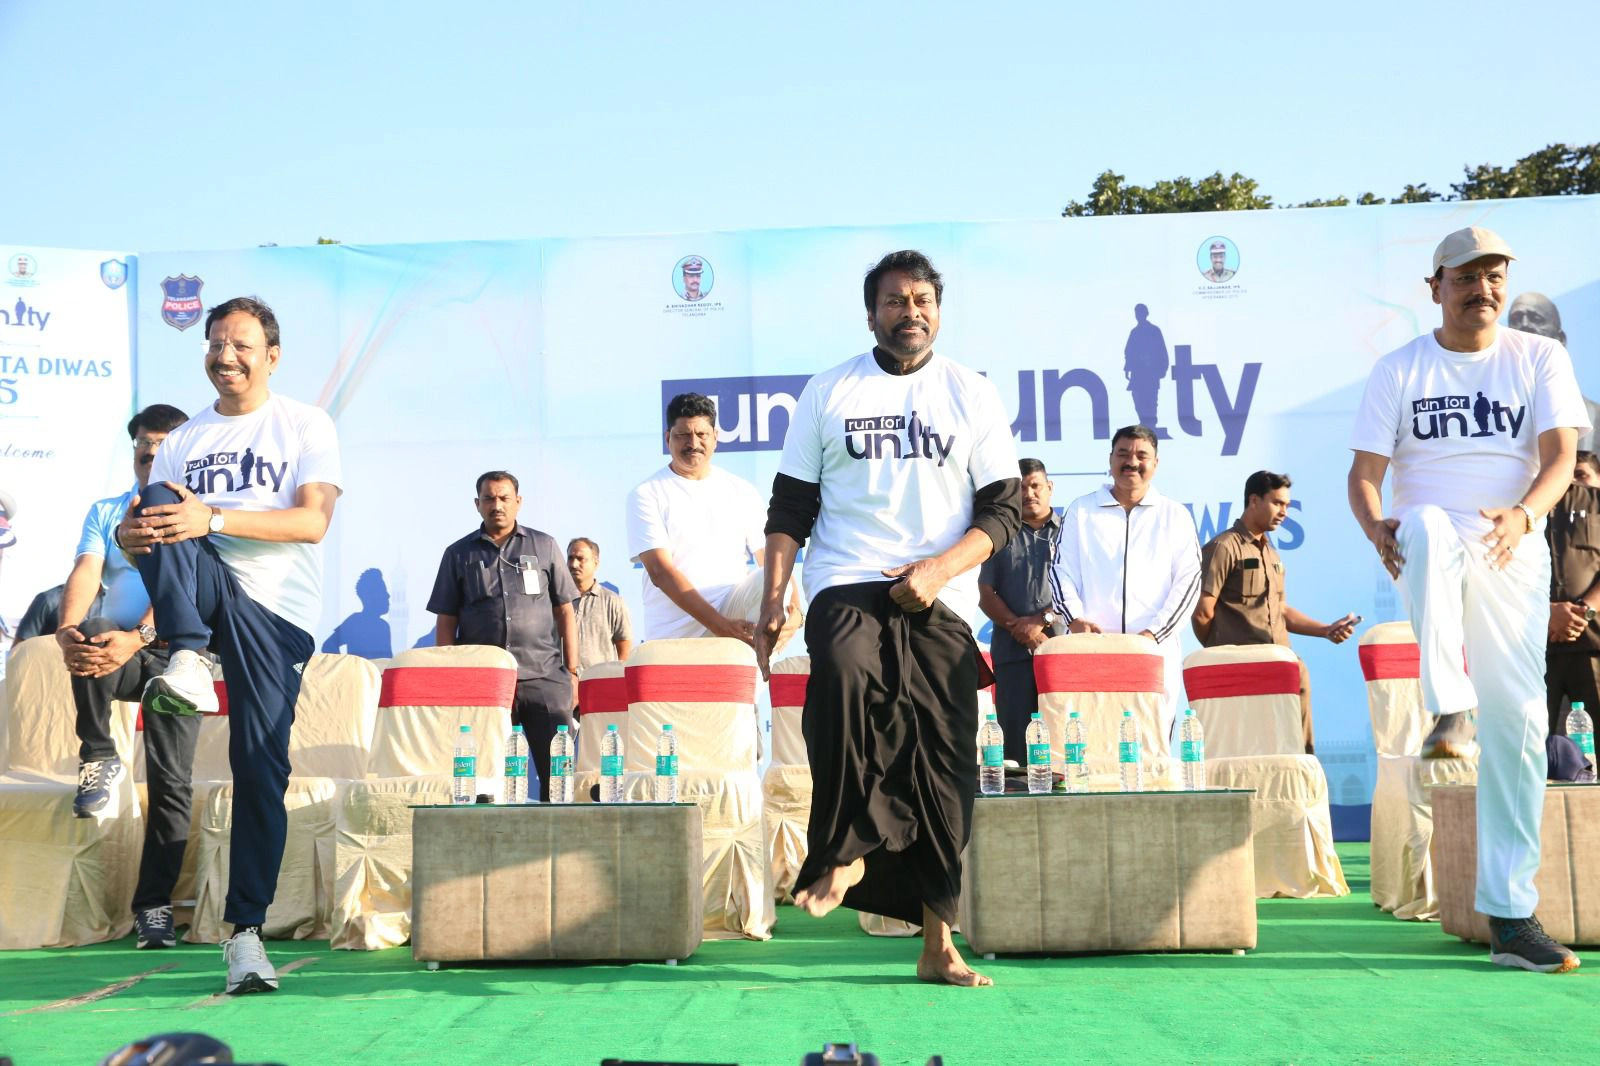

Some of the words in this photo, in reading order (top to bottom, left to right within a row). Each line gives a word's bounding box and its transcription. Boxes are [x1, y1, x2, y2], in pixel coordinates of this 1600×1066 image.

[164, 300, 201, 311] POLICE
[38, 357, 113, 377] DIWAS
[1416, 399, 1440, 412] run
[1444, 396, 1466, 409] for
[847, 419, 875, 431] run
[879, 416, 901, 429] for
[188, 457, 209, 471] run
[213, 453, 235, 466] for
